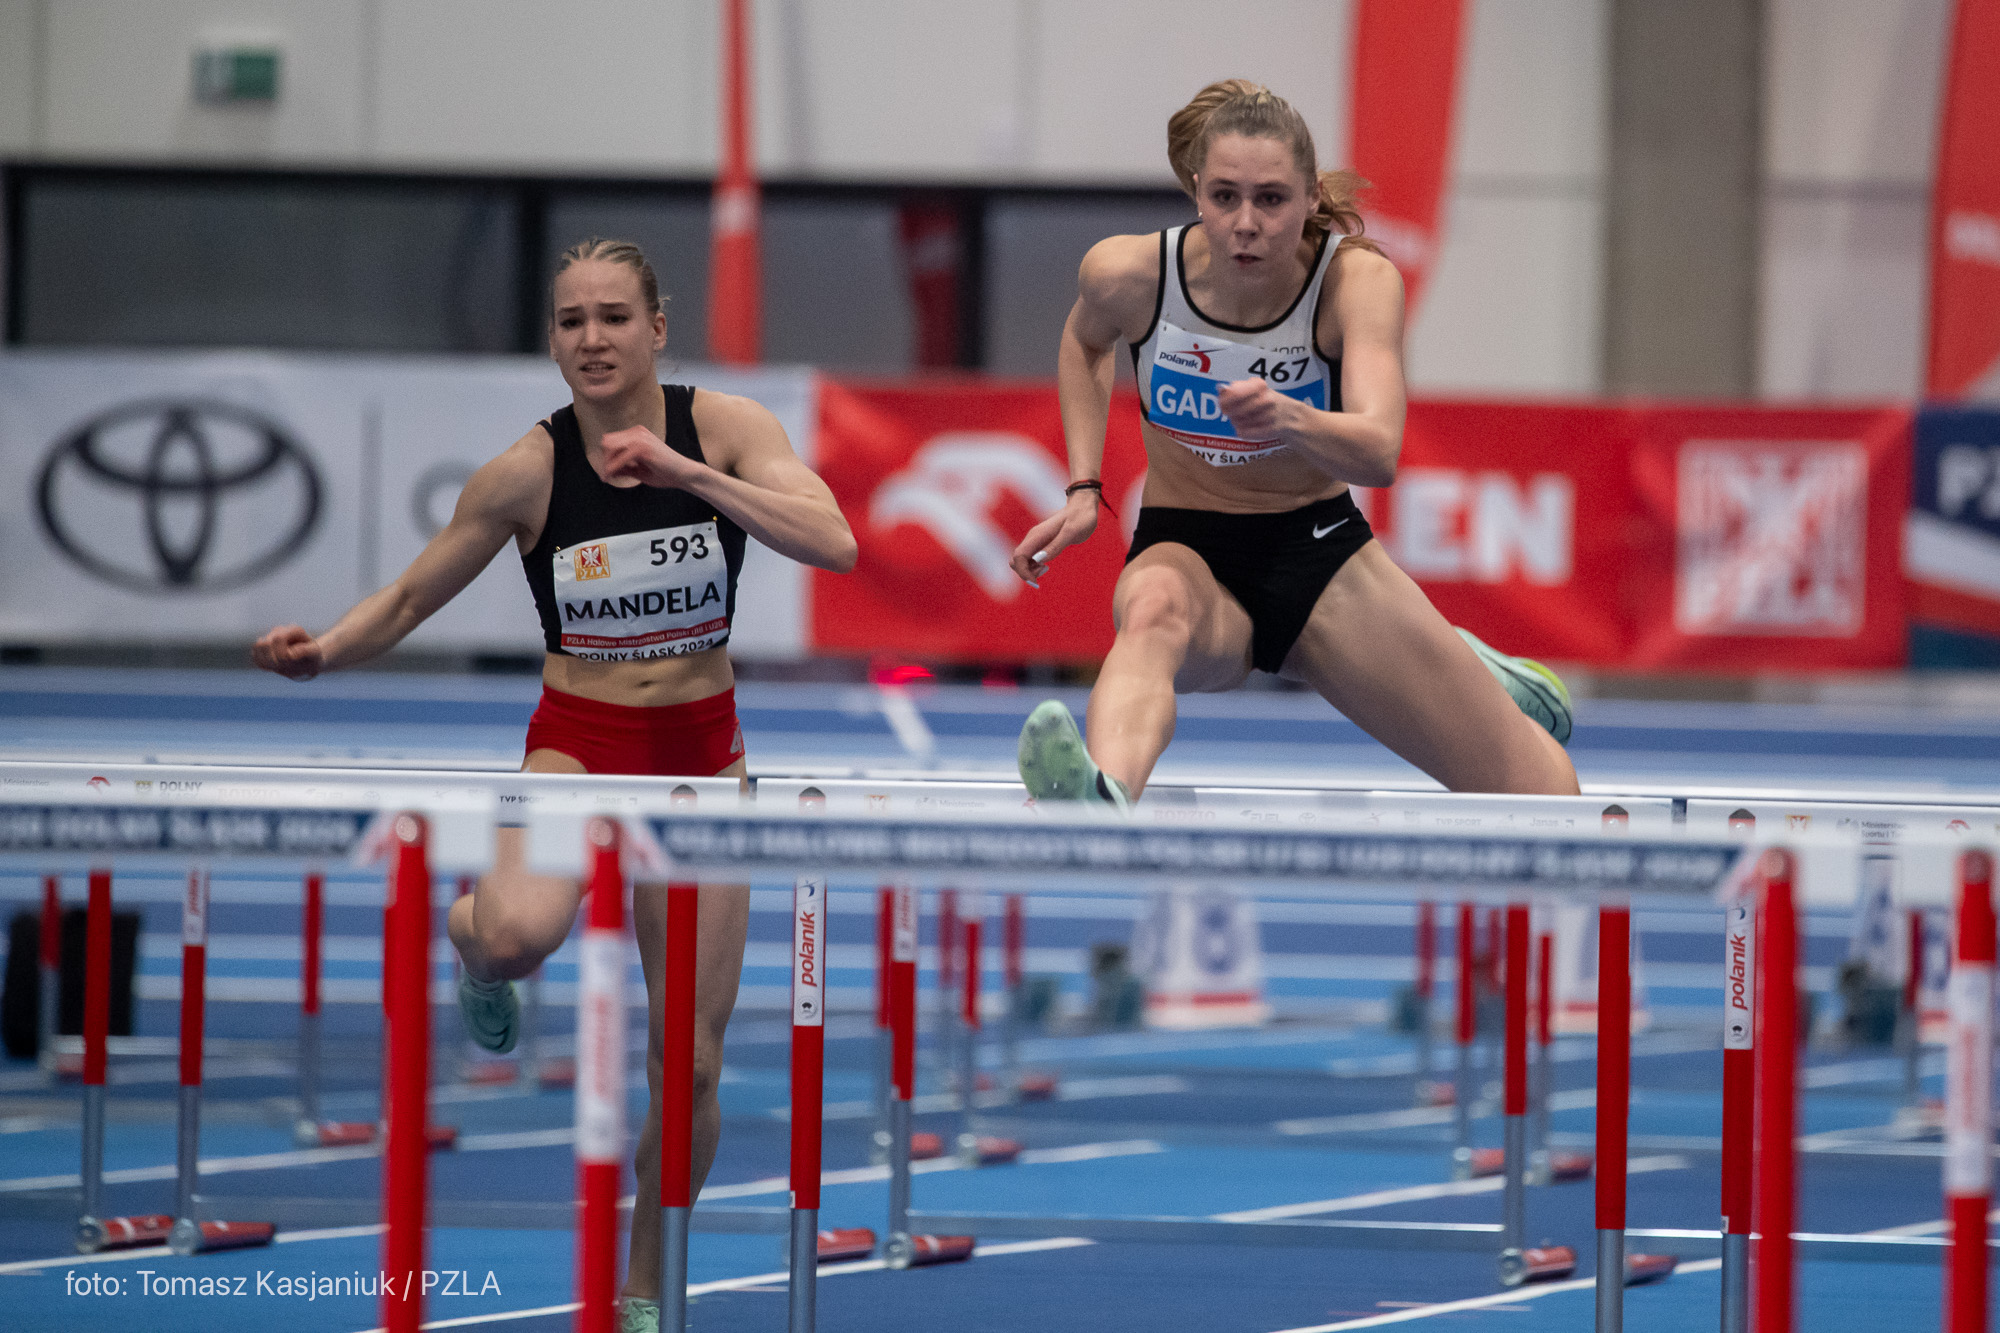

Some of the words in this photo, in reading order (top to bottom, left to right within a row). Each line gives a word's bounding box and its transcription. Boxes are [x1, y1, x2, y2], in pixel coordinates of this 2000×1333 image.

[1158, 351, 1198, 369] polanik
[1247, 356, 1310, 383] 467
[650, 533, 710, 566] 593
[577, 567, 609, 580] PZLA
[564, 581, 721, 621] MANDELA
[566, 636, 586, 646] PZLA
[586, 636, 617, 647] Halowe
[618, 632, 665, 646] Mistrzostwa
[666, 629, 690, 640] Polski
[708, 619, 724, 631] U20
[578, 651, 628, 662] DOLNY
[680, 637, 714, 654] 2024
[159, 780, 203, 792] DOLNY
[500, 795, 517, 803] TVP
[798, 909, 818, 989] polanik
[1729, 933, 1749, 1011] polanik
